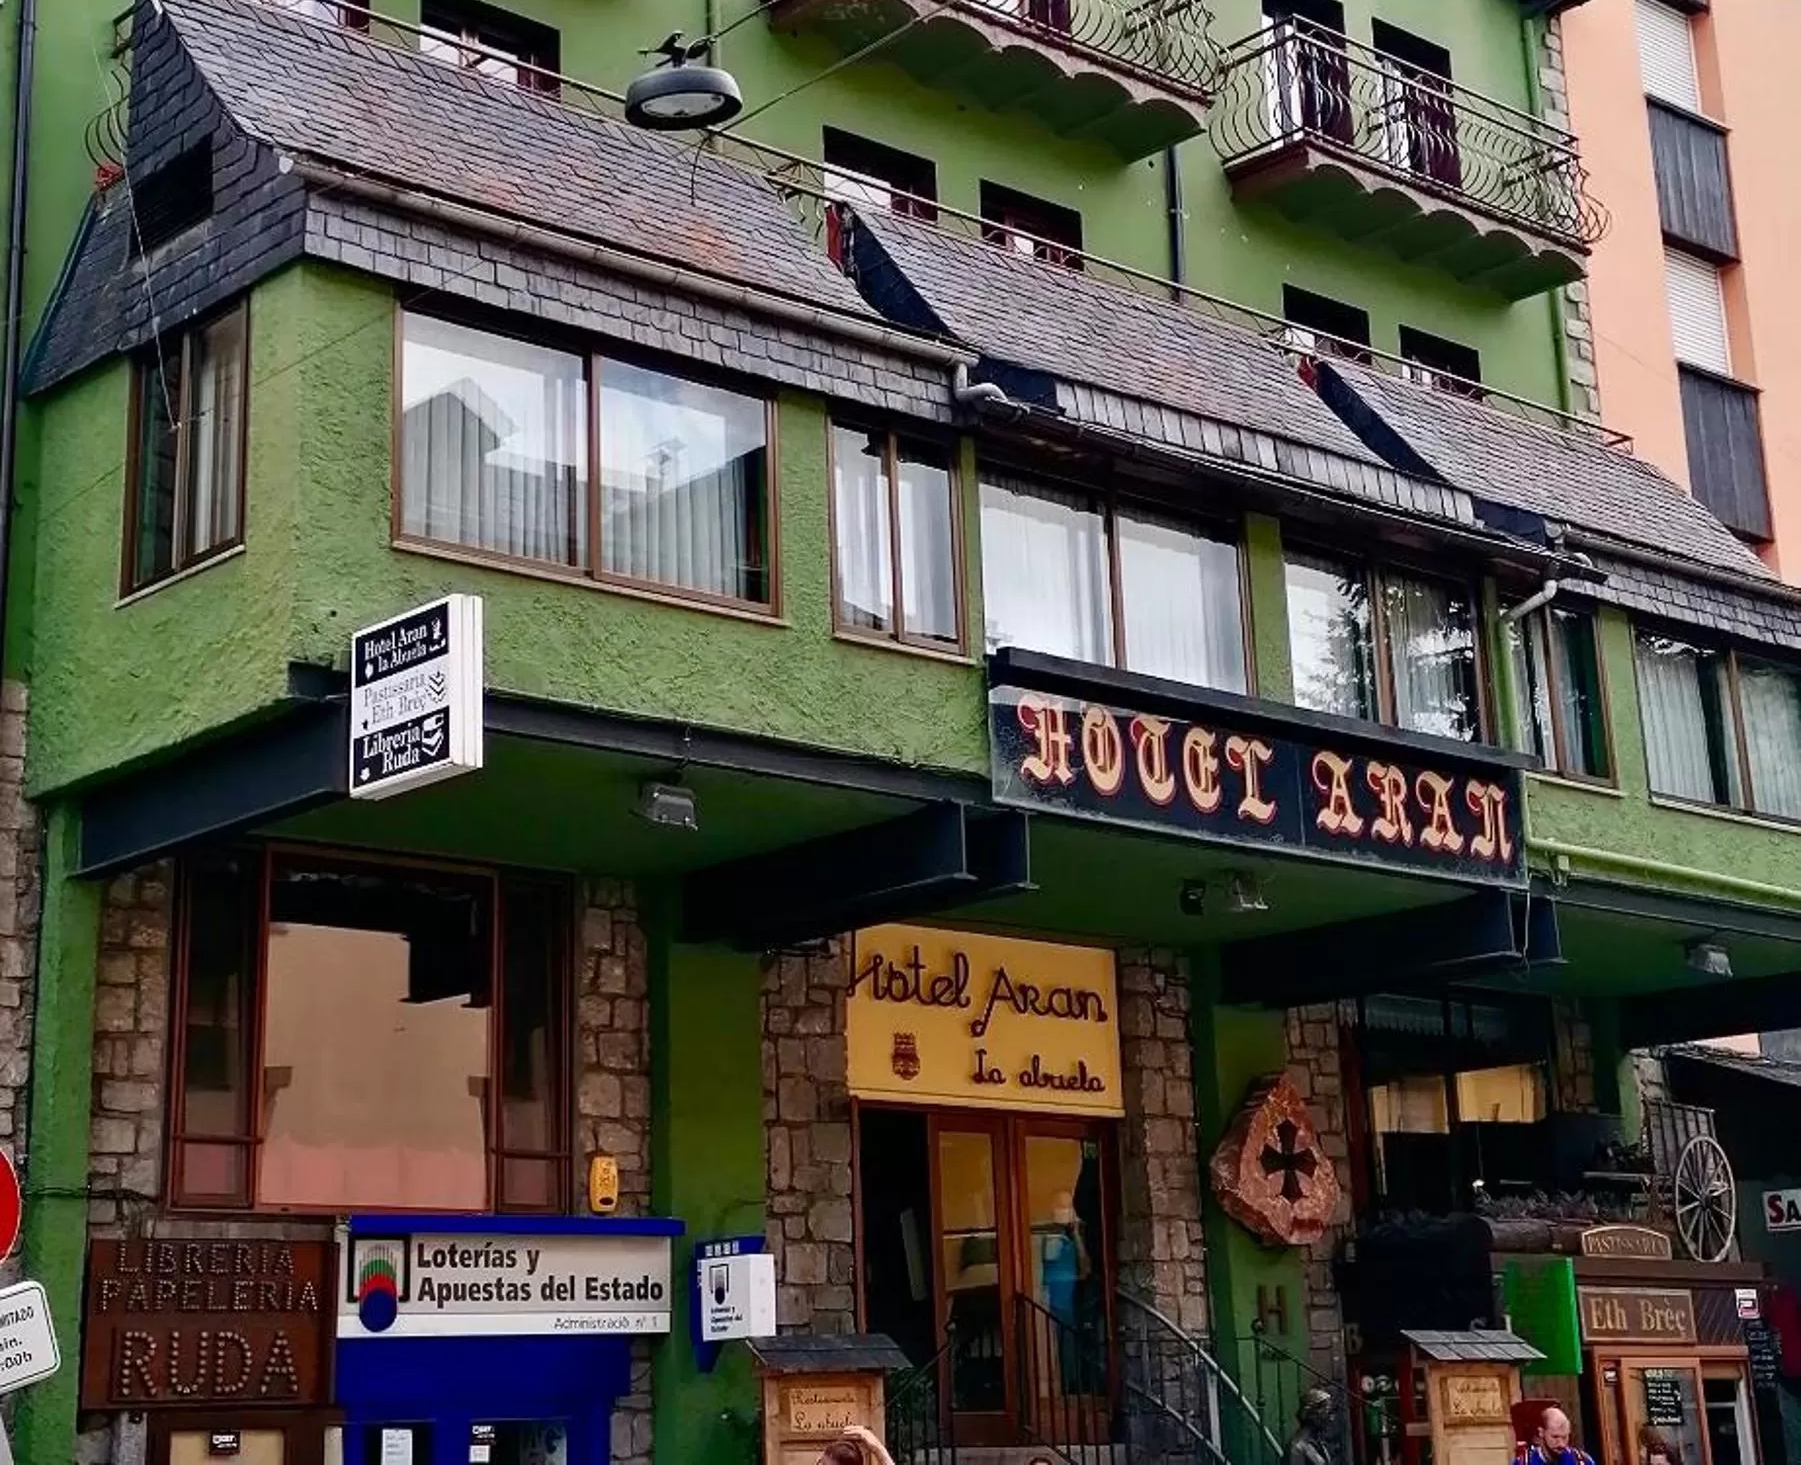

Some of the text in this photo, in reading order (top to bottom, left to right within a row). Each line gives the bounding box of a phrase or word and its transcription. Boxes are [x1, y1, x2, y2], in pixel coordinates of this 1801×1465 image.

[364, 624, 428, 662] Hotel Aran
[390, 641, 427, 669] Abuela
[382, 743, 420, 774] Ruda
[1017, 693, 1513, 865] HOTEL ARAN
[846, 944, 1109, 1038] Hotel Aran
[1019, 1054, 1106, 1093] abuela
[117, 1242, 296, 1275] LIBRERIA
[417, 1241, 540, 1275] Loterías y
[102, 1279, 319, 1312] PAPELERIA
[417, 1274, 664, 1309] Apuestas del Estado
[1588, 1297, 1629, 1331] Eth
[120, 1331, 299, 1396] RUDA
